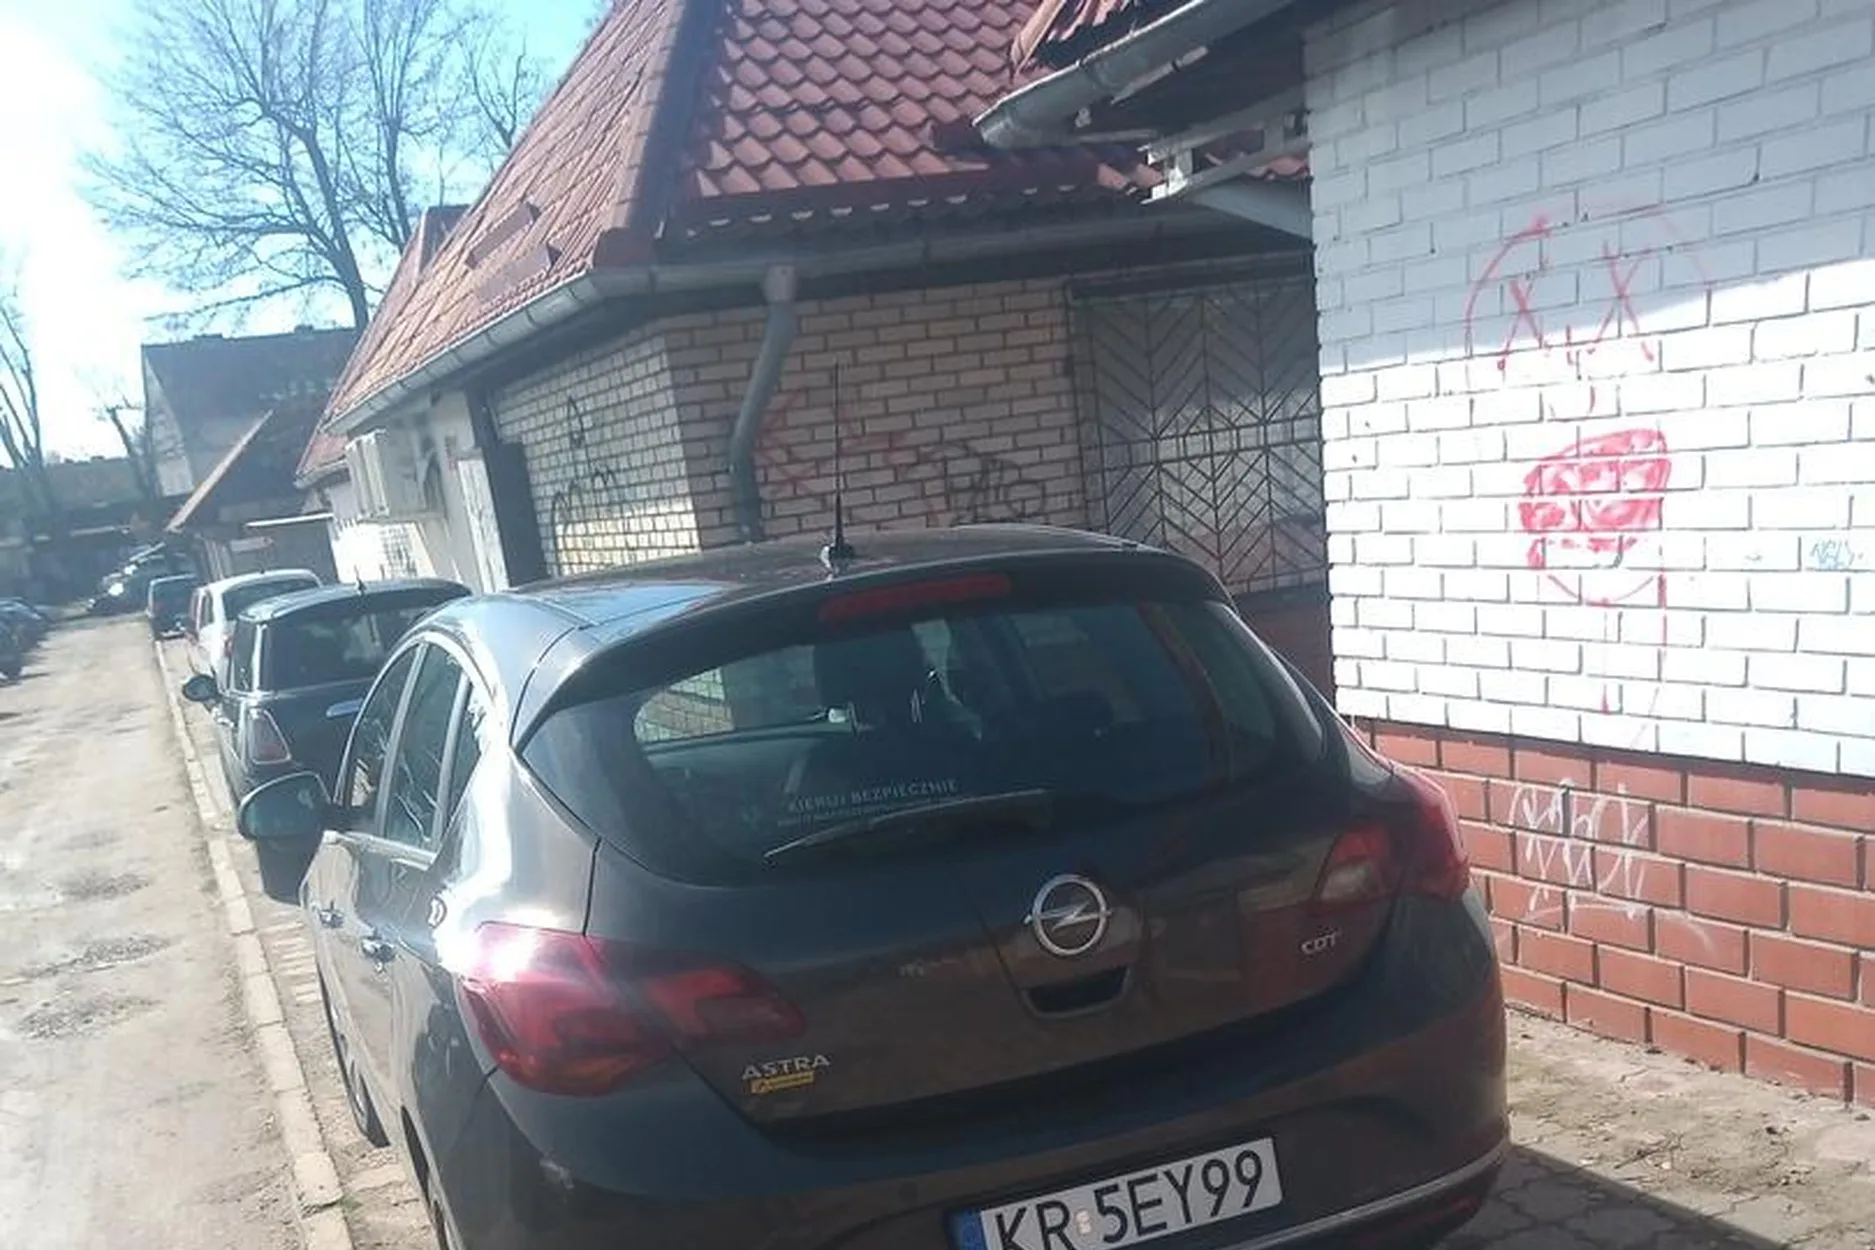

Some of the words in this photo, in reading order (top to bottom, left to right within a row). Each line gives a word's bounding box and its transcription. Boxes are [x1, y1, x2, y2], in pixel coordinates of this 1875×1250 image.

[851, 779, 959, 804] BEZPIECZNIE
[742, 1055, 831, 1080] ASTRA
[1095, 1150, 1262, 1244] 5EY99
